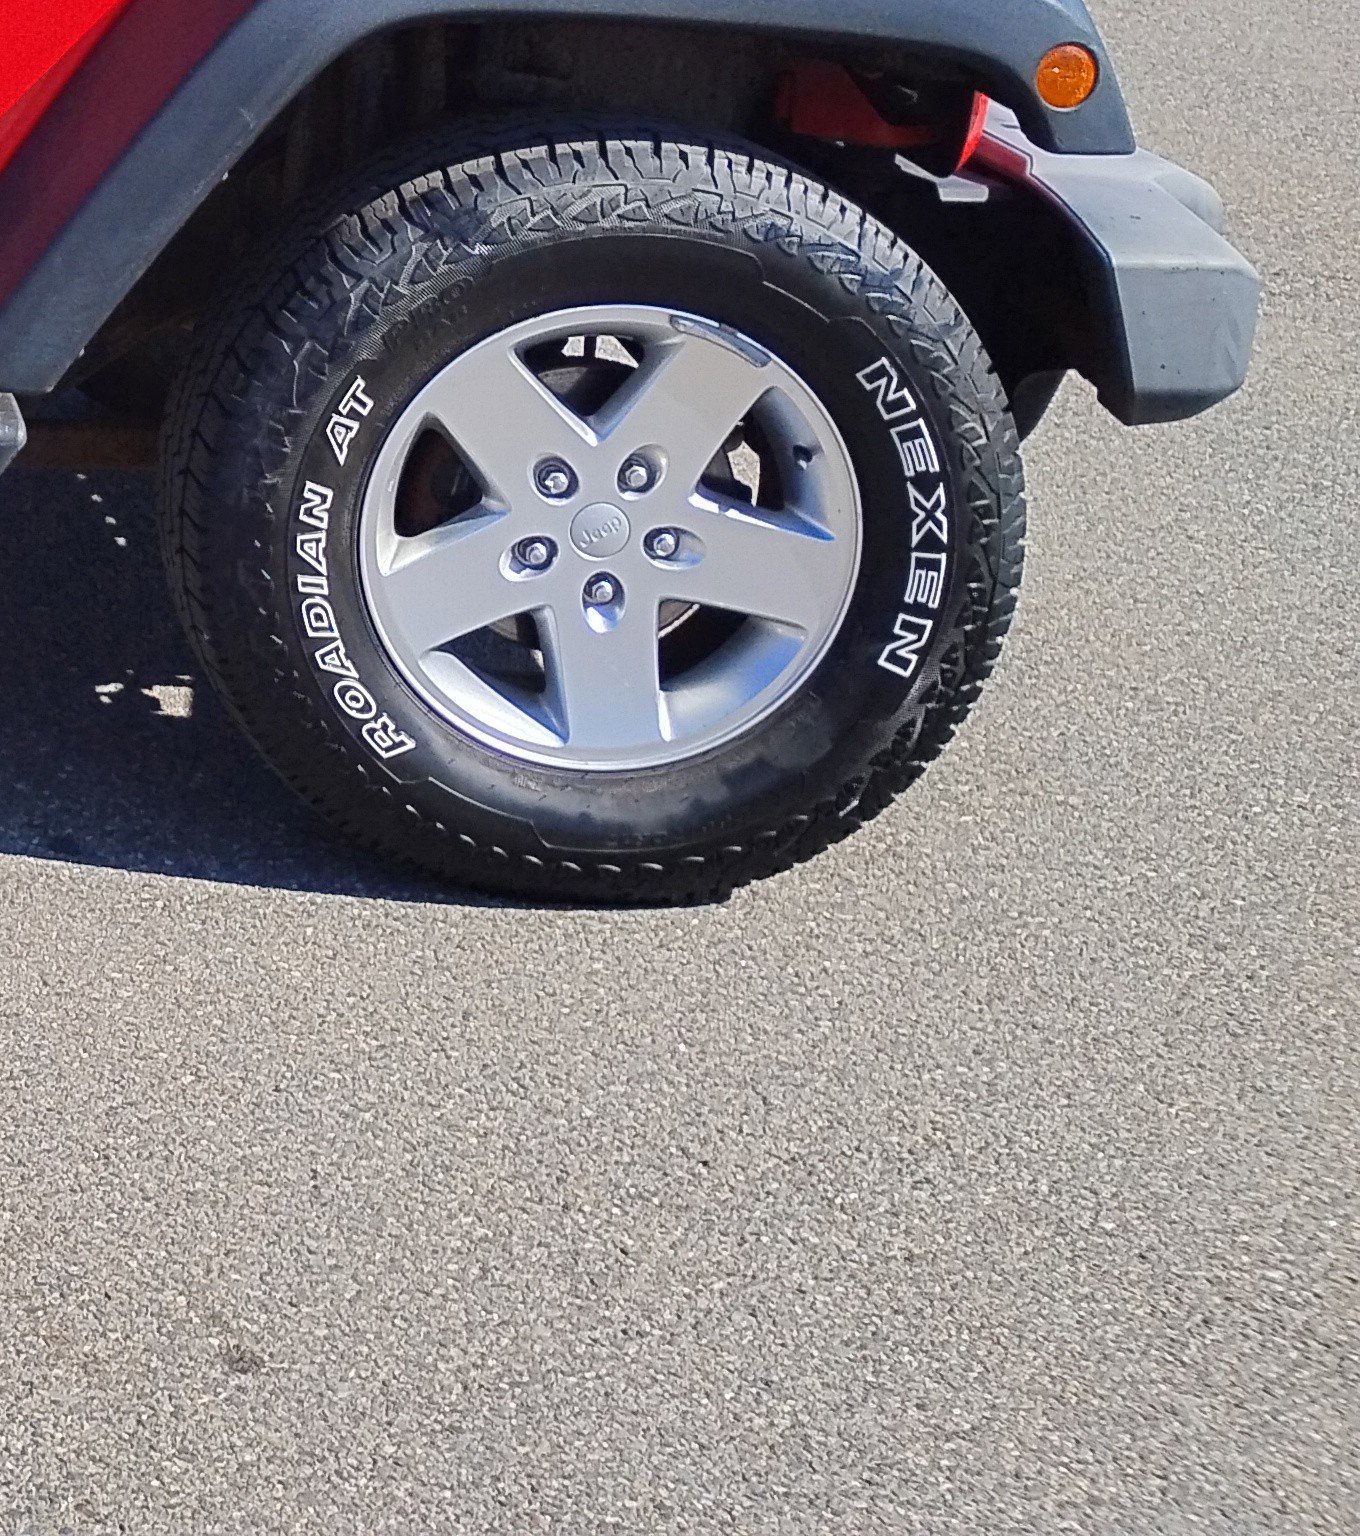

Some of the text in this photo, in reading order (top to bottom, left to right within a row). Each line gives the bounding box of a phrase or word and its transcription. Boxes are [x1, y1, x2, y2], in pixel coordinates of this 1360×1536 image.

[296, 375, 416, 760] ROADIAN AT
[579, 516, 622, 549] Jeep
[855, 356, 947, 678] NEXEN
